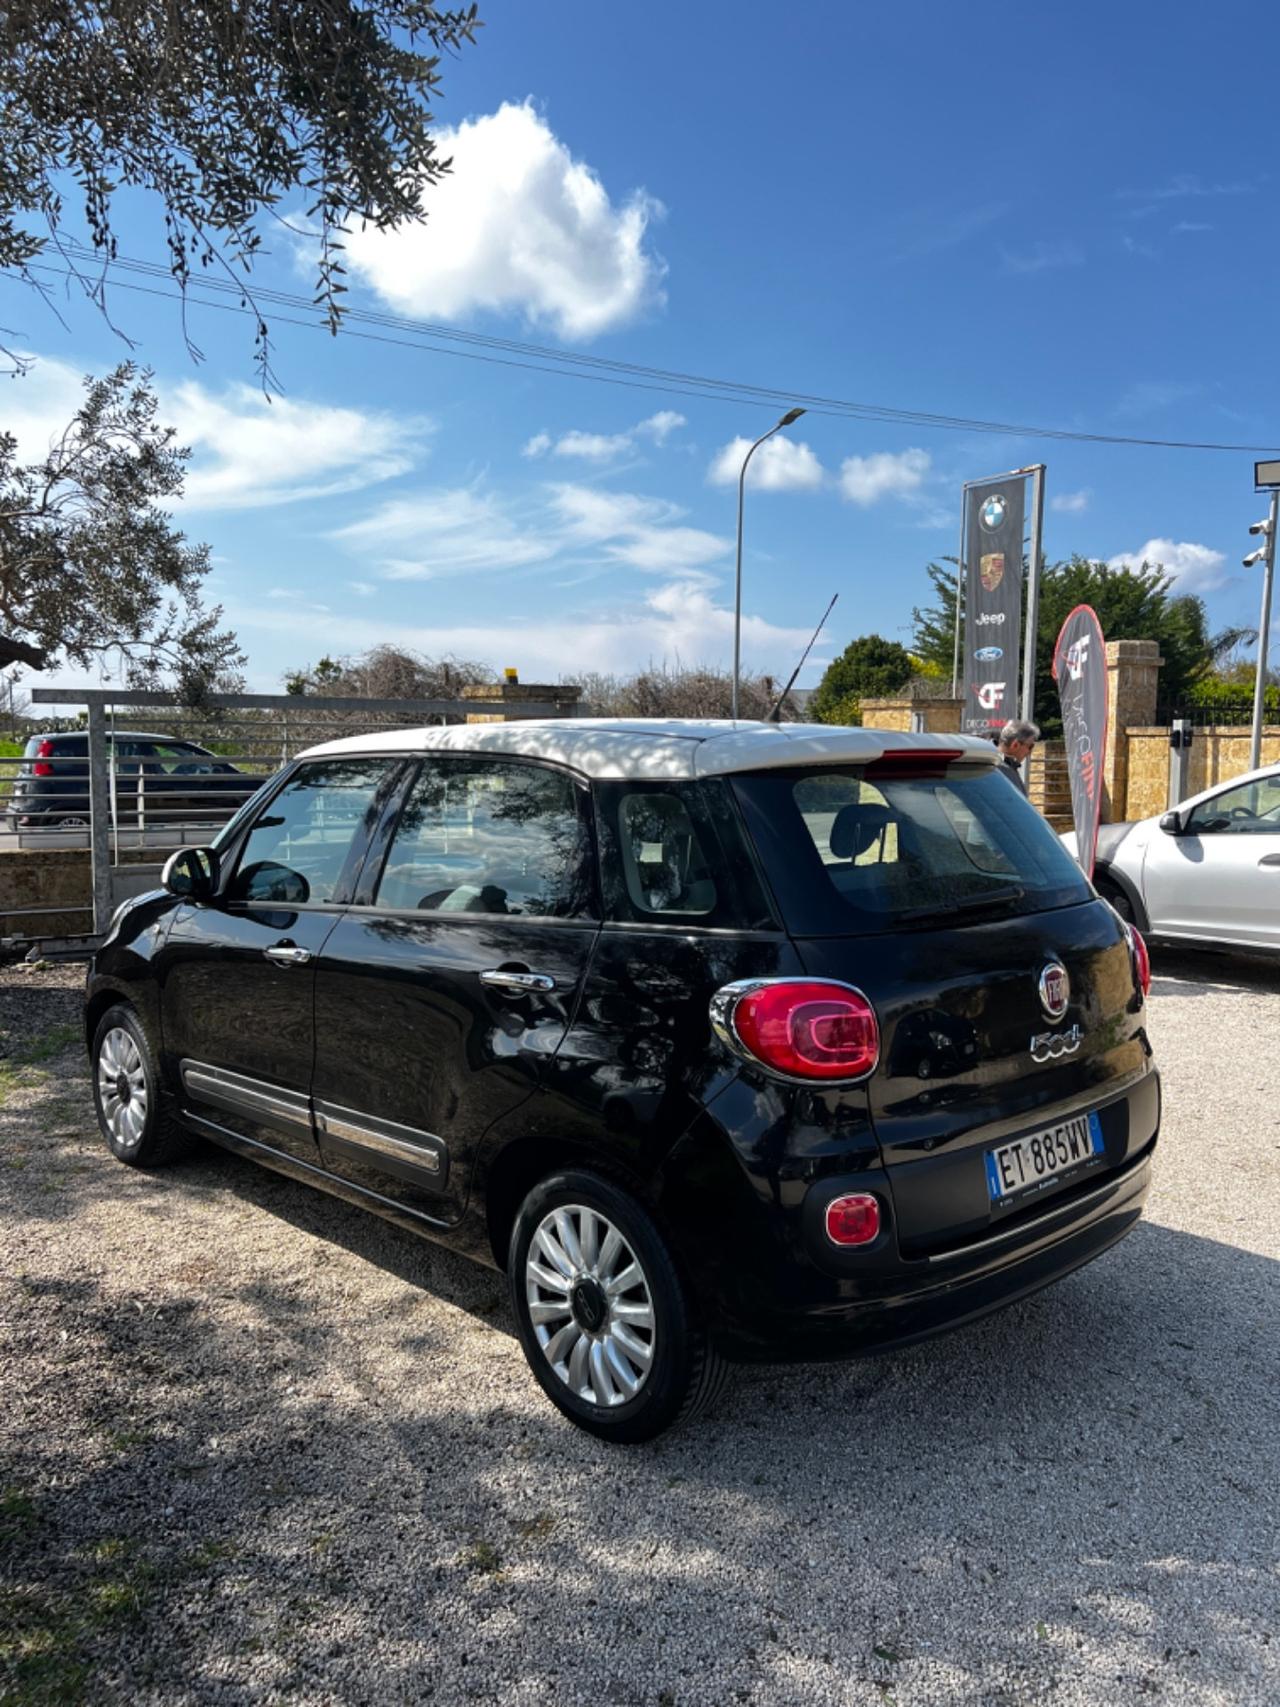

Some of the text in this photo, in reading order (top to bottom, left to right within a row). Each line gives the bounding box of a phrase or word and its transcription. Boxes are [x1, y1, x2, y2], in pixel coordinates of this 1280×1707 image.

[975, 612, 1005, 626] Jeep
[998, 1143, 1025, 1190] ET
[1030, 1117, 1090, 1175] 885WV
